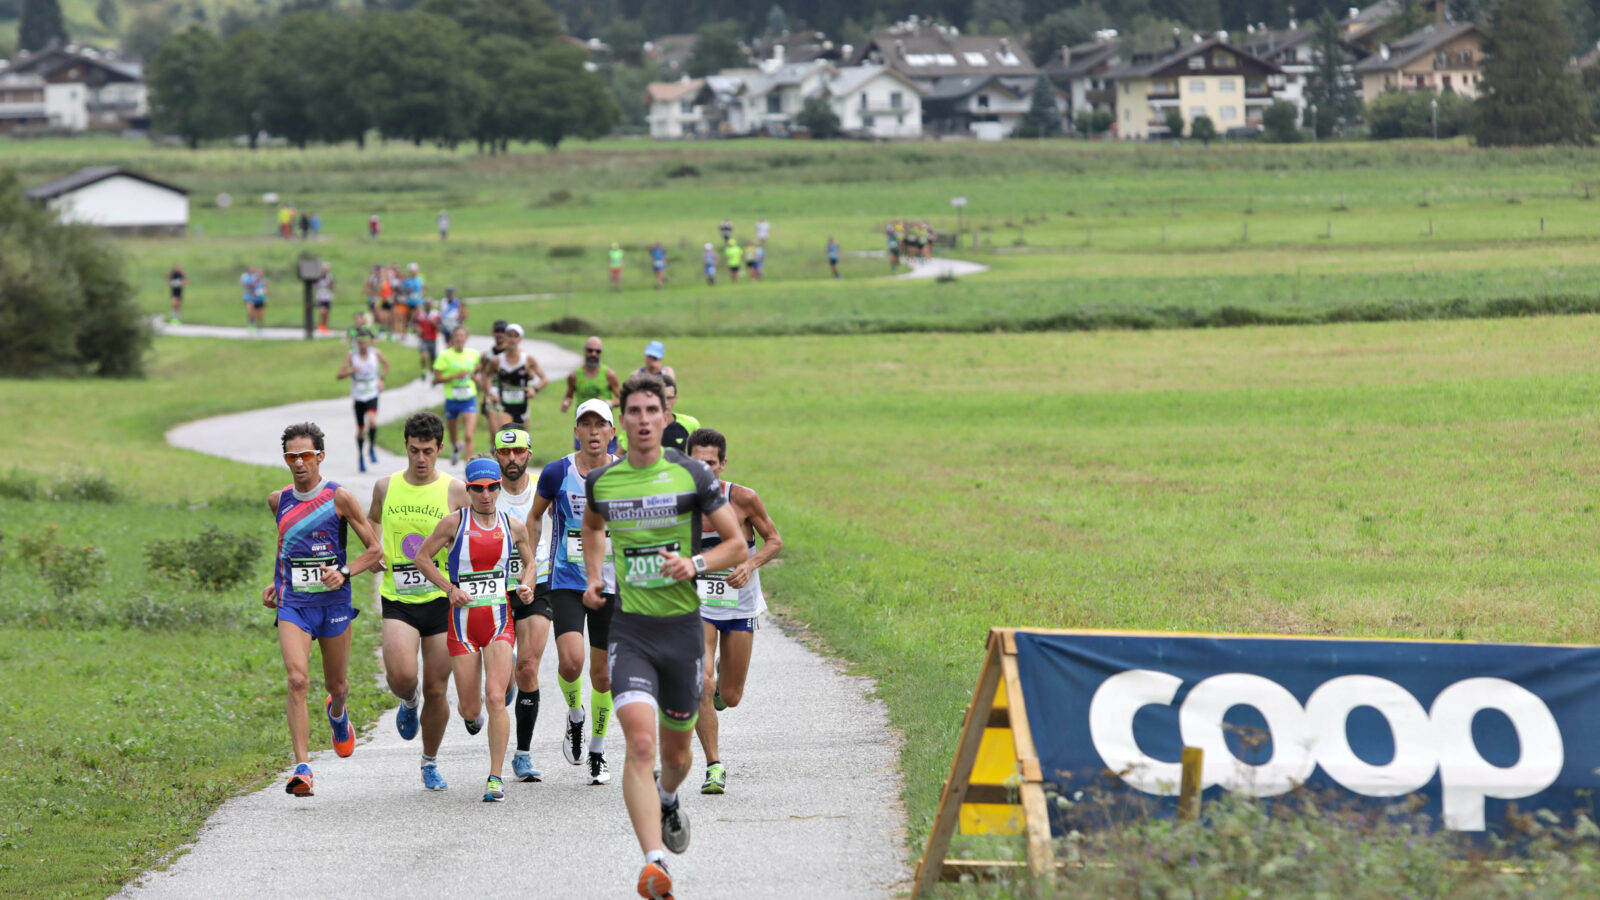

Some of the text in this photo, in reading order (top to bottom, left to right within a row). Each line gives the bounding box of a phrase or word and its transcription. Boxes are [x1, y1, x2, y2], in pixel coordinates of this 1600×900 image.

[608, 507, 678, 521] Robinson
[628, 554, 666, 576] 2019
[469, 580, 497, 596] 379
[706, 581, 725, 595] 38
[1089, 668, 1565, 832] coop
